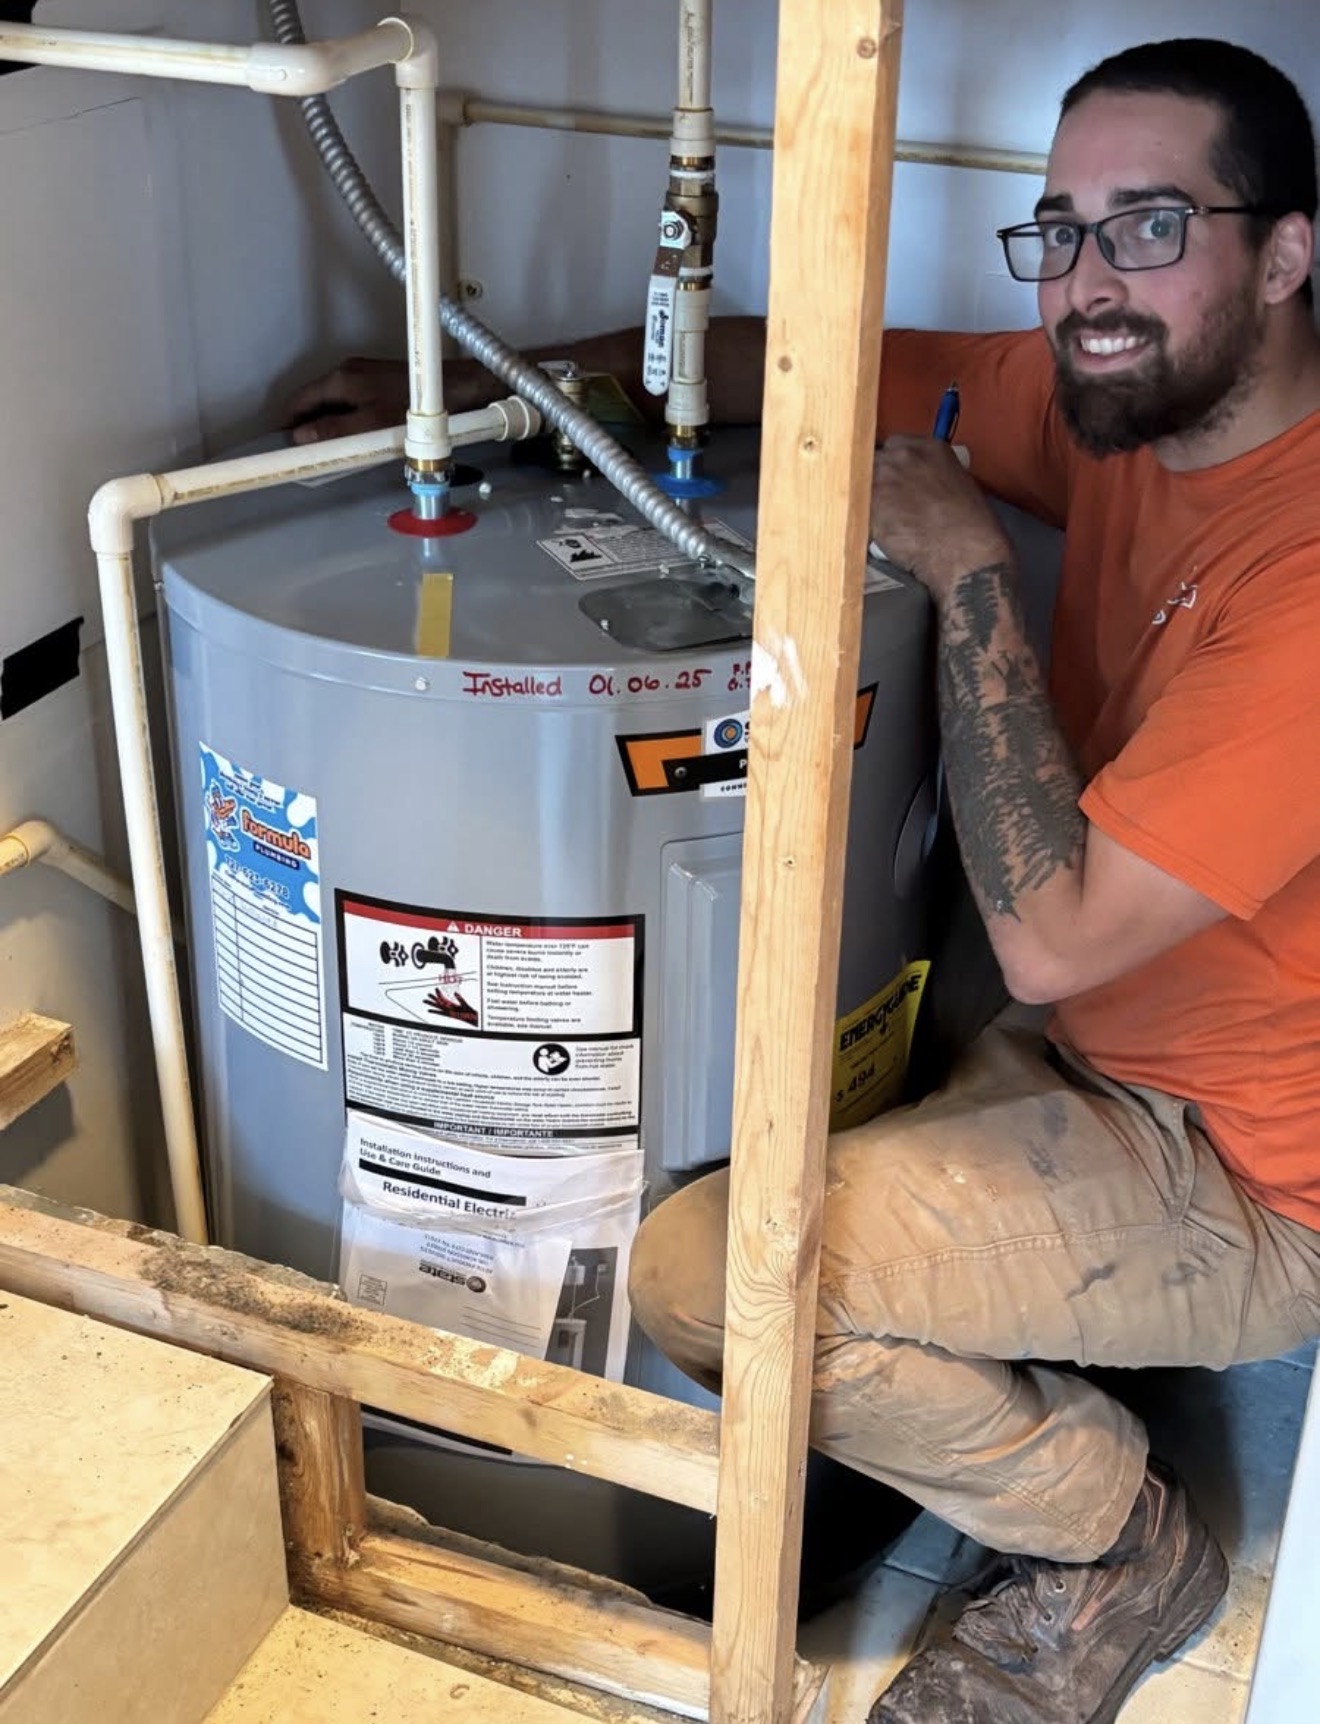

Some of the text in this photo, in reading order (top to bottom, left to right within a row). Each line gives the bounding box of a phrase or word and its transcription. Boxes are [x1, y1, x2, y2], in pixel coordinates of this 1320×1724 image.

[462, 670, 563, 697] Installed
[241, 808, 312, 860] formula
[255, 843, 298, 868] PLUMBING
[464, 923, 522, 937] DANGER
[434, 1121, 486, 1135] IMPORTANT
[494, 1128, 554, 1138] IMPORTANTE
[360, 1137, 491, 1179] Installation Instructions and
[360, 1147, 442, 1177] Use & Care Guide
[383, 1180, 461, 1210] Residential
[418, 1266, 466, 1286] state
